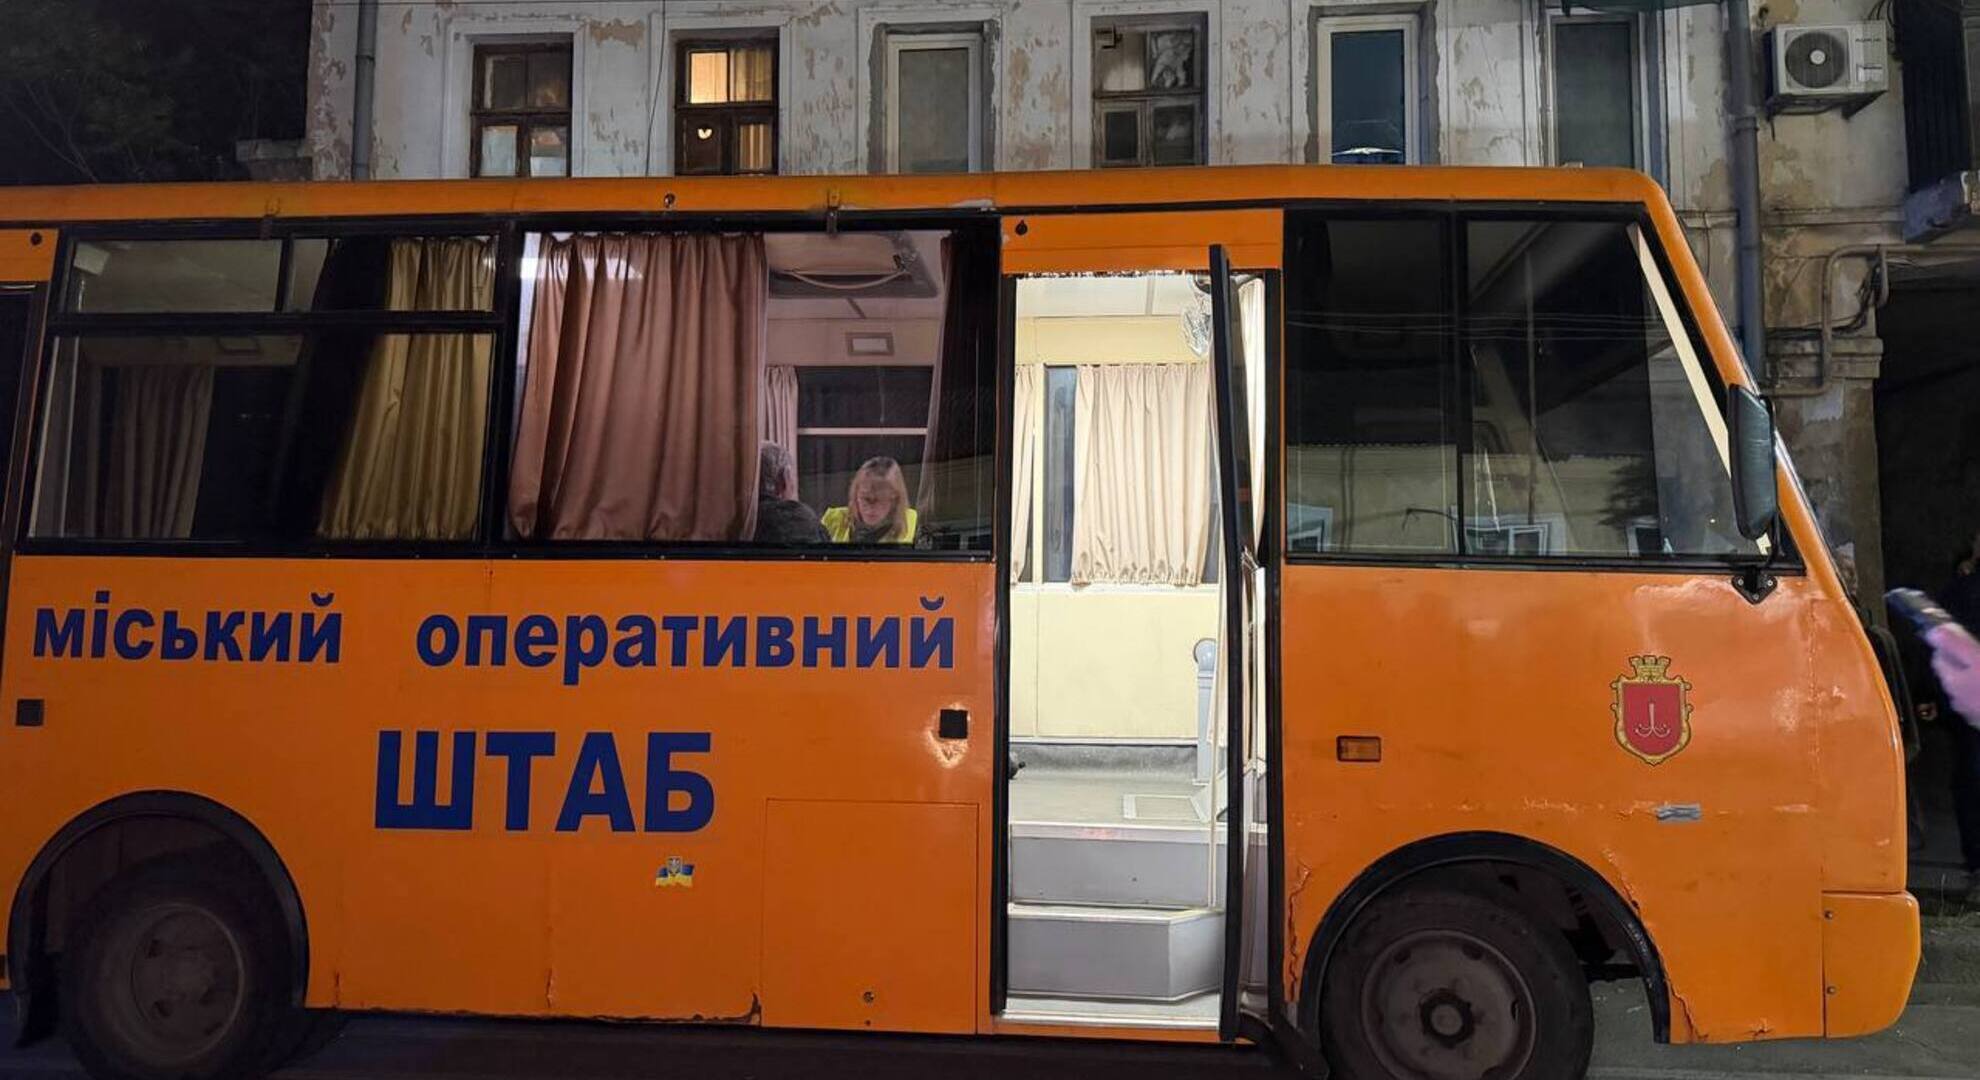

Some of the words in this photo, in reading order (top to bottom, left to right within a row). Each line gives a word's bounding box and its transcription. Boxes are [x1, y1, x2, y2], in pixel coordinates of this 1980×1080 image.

[33, 590, 343, 662] міський
[416, 596, 955, 686] оперативний
[375, 729, 715, 833] ШТАБ
